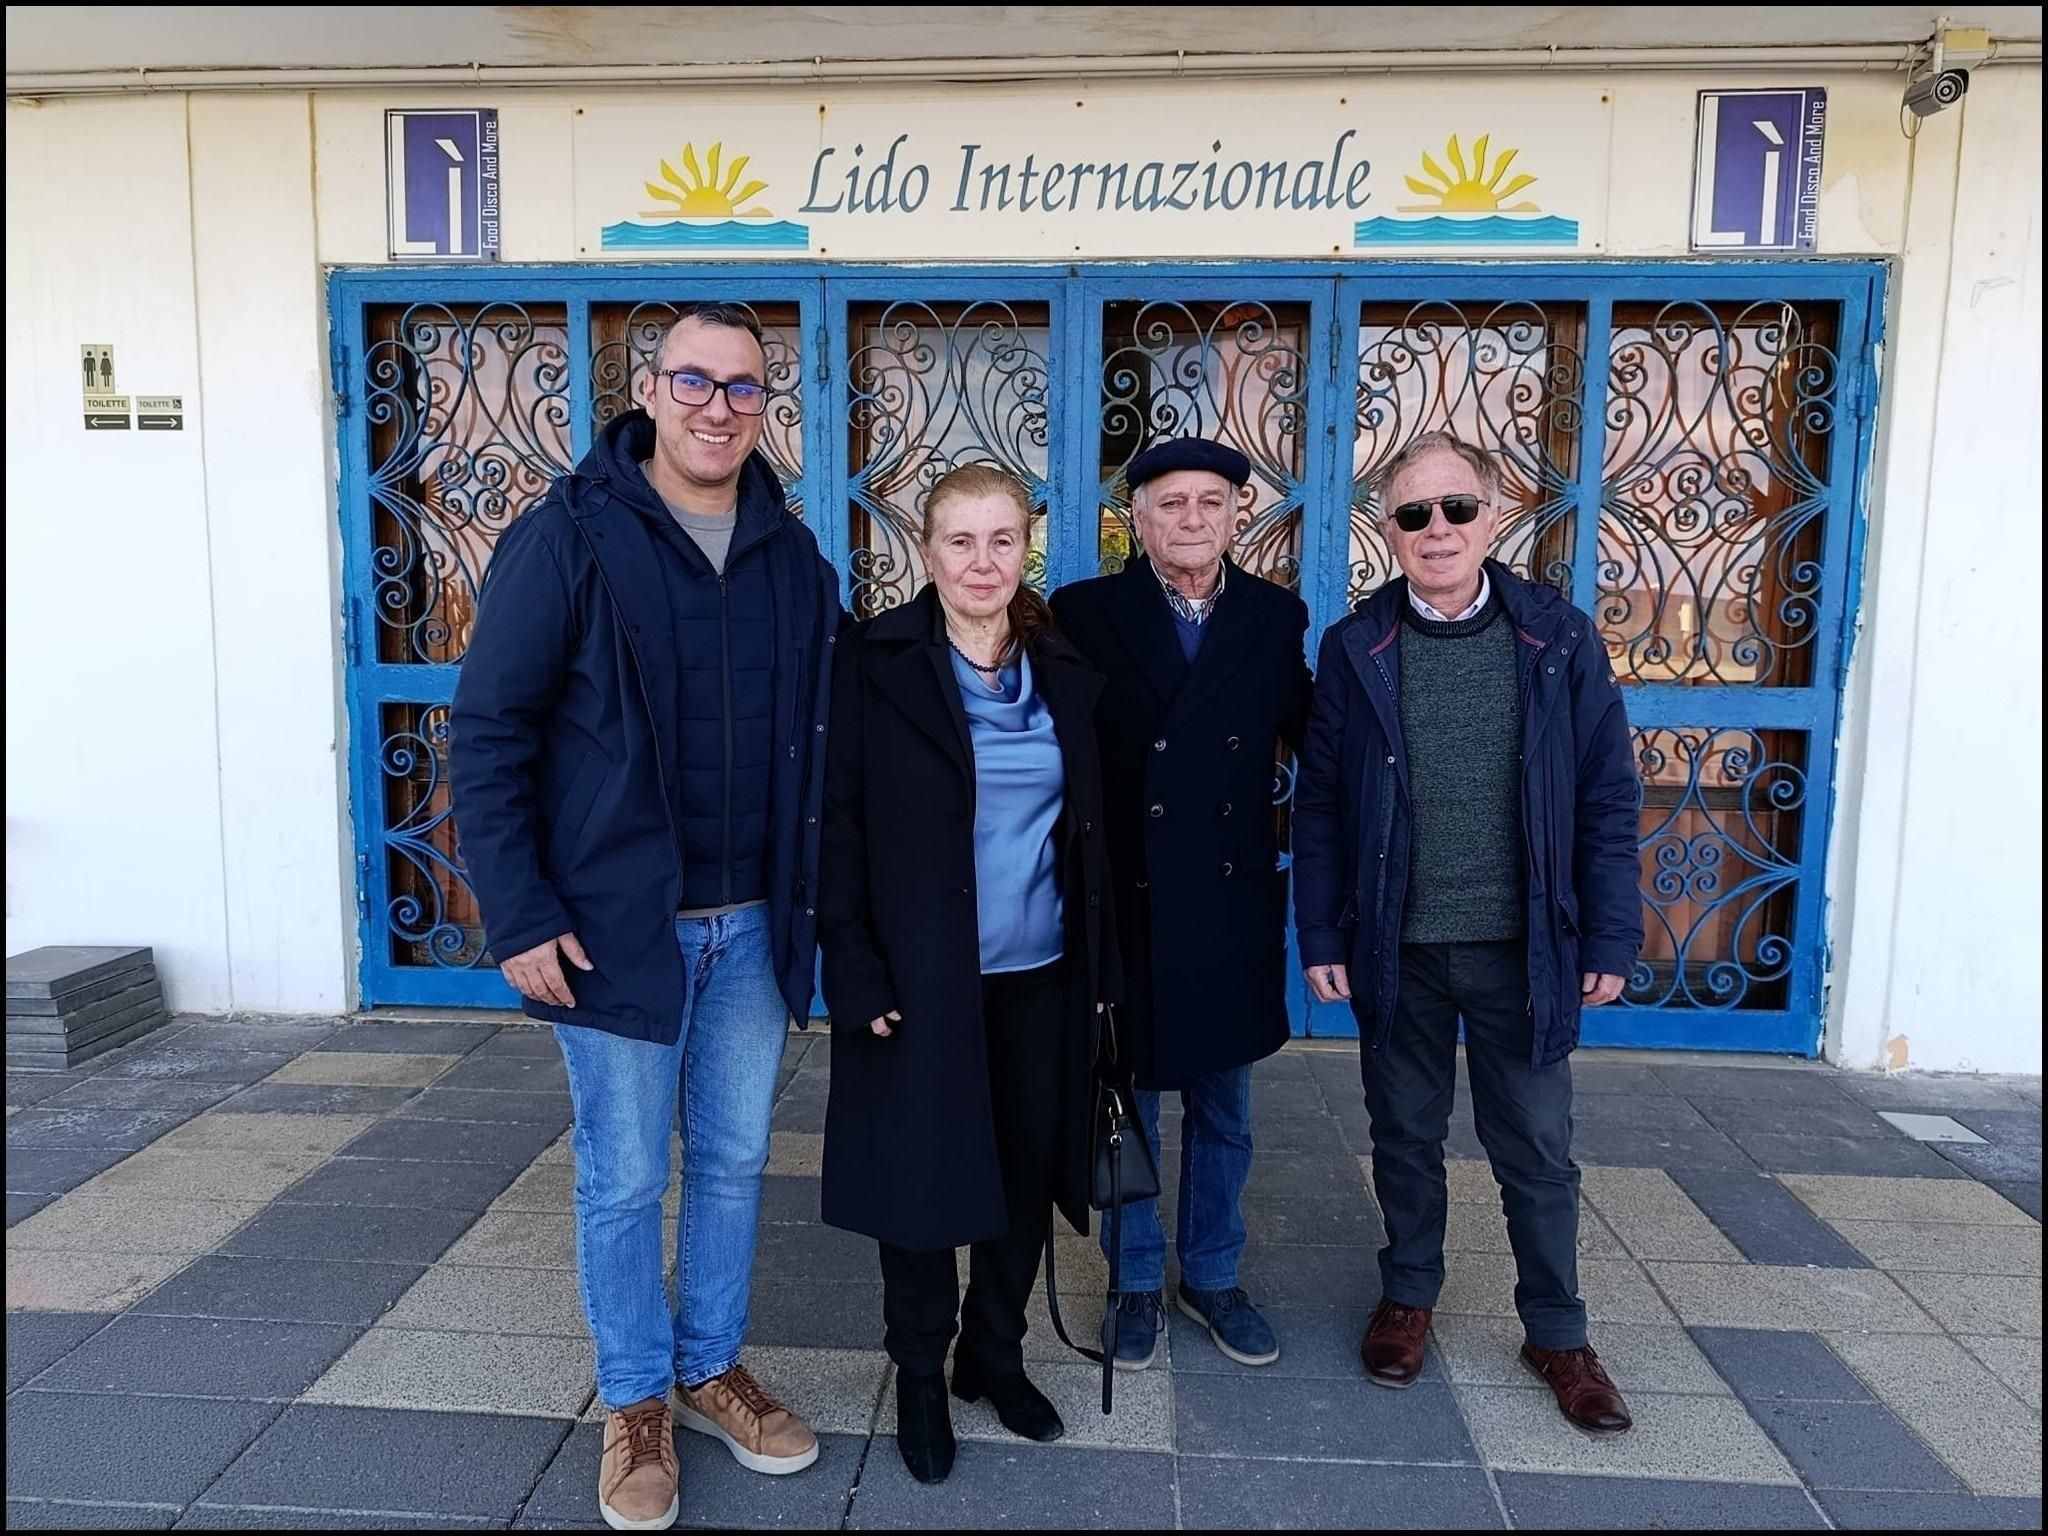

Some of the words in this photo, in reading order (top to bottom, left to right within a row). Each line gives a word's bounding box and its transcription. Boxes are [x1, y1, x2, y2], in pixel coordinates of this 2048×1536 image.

[1805, 101, 1825, 136] More
[481, 121, 497, 153] More
[1803, 140, 1822, 163] And
[481, 156, 497, 179] And
[798, 134, 930, 213] Lido
[949, 129, 1373, 212] Internazionale
[482, 183, 498, 216] Disco
[1800, 169, 1820, 204] Disco
[482, 220, 498, 249] Food
[1799, 208, 1816, 239] Food
[87, 399, 127, 408] TOILETTE
